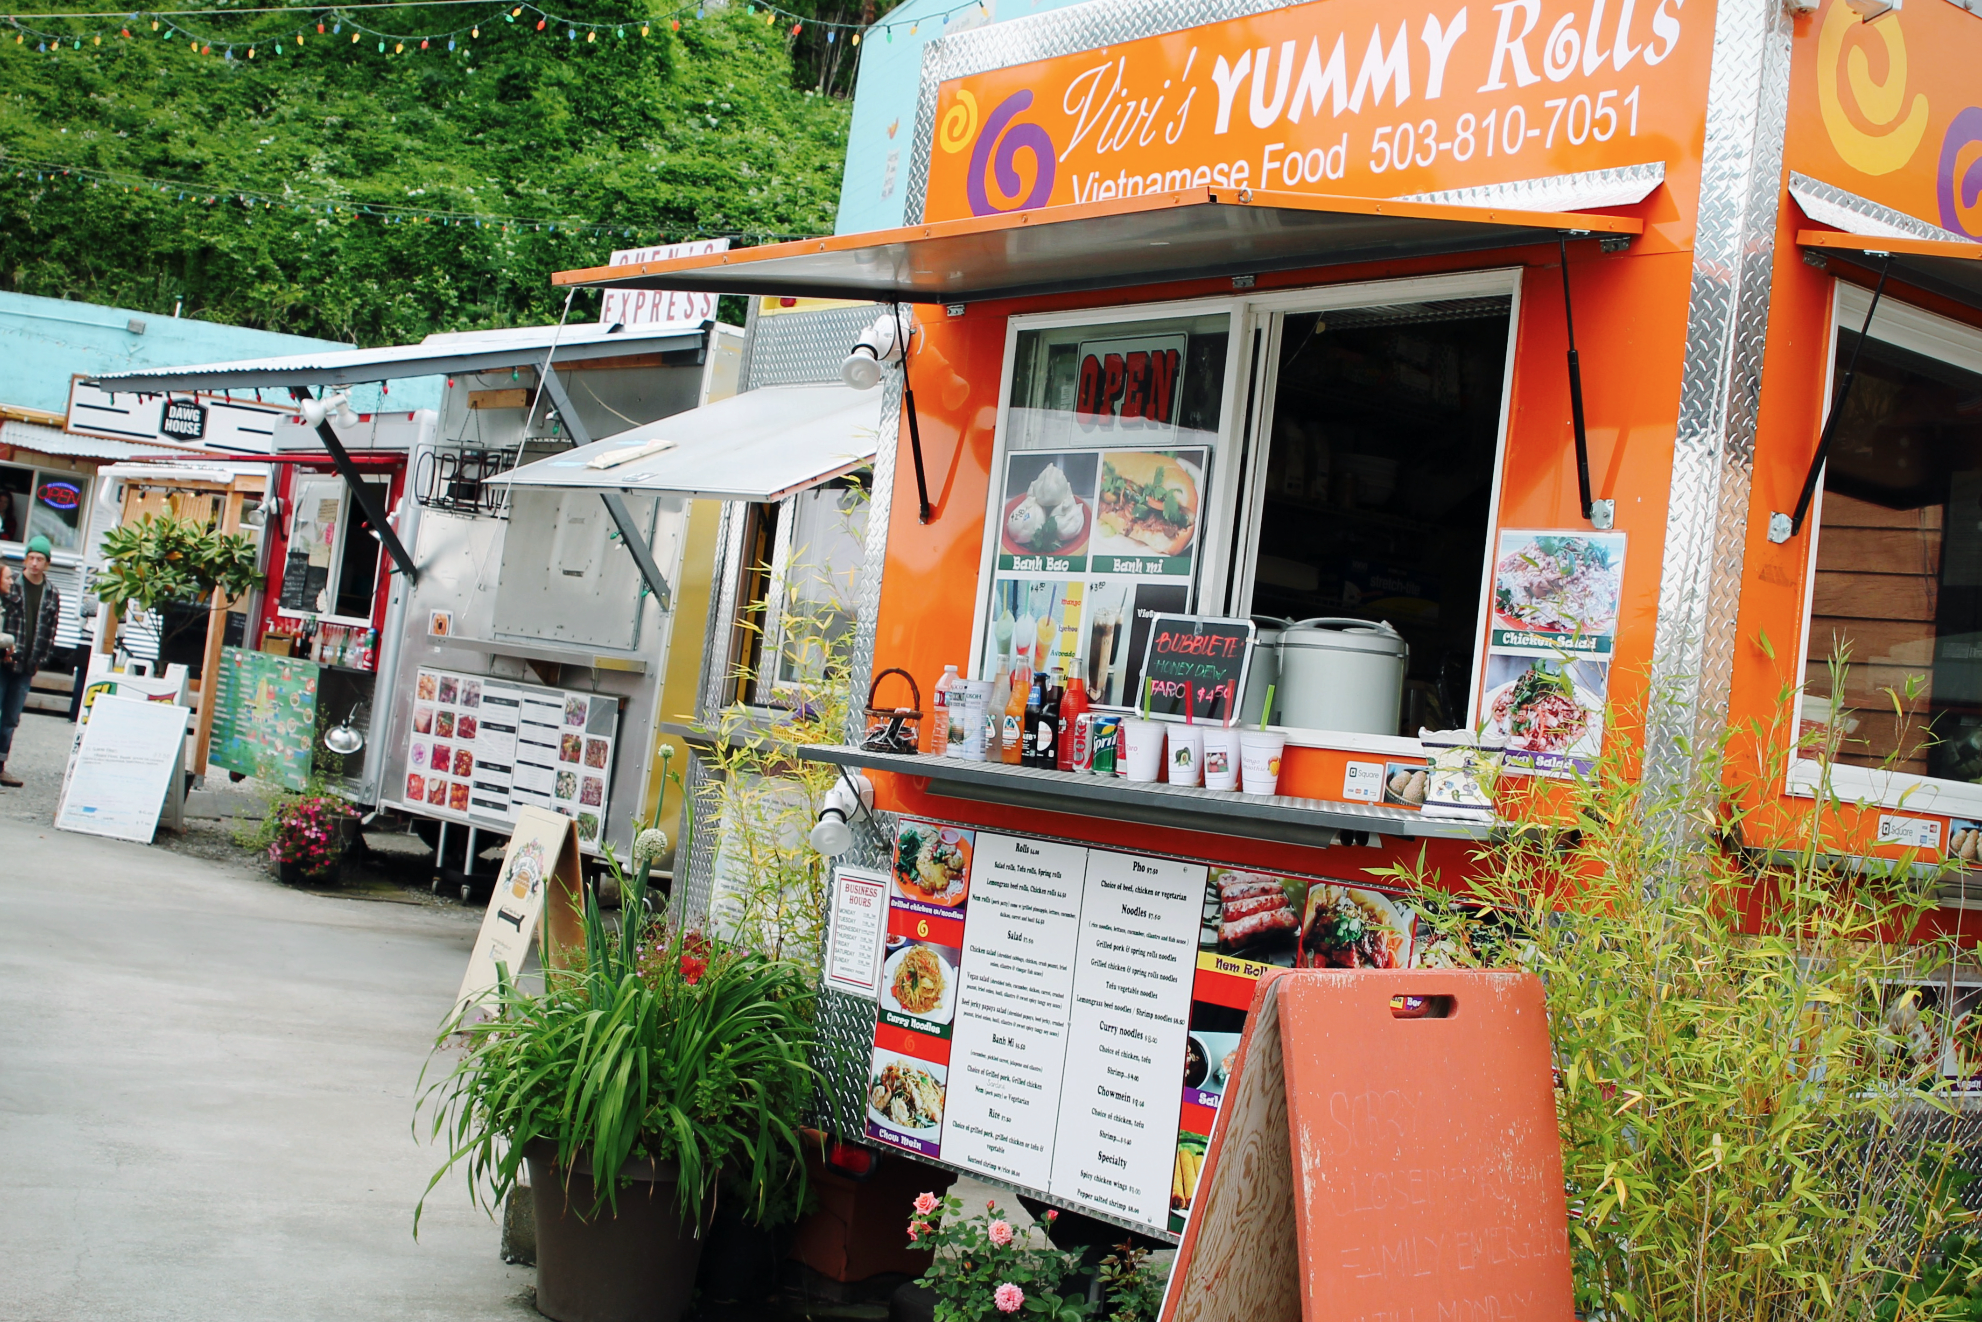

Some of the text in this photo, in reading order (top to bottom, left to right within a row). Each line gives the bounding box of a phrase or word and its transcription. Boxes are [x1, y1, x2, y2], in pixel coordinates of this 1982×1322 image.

[1059, 0, 1685, 163] Vivi's YUMMY Rolls
[1261, 132, 1348, 190] Food
[1369, 85, 1640, 174] 503-810-7051
[603, 290, 711, 324] EXPRESS
[1076, 348, 1180, 432] OPEN
[168, 406, 201, 422] DAWG
[164, 418, 201, 436] HOUSE
[37, 484, 82, 507] OPEN
[1012, 556, 1070, 573] Banh Bao
[1113, 558, 1163, 574] Banh mi
[1557, 635, 1597, 650] Salad
[1154, 660, 1227, 680] HONEY DEW
[1150, 680, 1186, 698] TARO
[1536, 755, 1574, 769] Salad
[1358, 769, 1380, 779] Square
[1891, 825, 1913, 837] Square
[1016, 843, 1029, 854] Rolls
[1133, 861, 1146, 872] Pho
[845, 883, 878, 898] BUSINESS
[1101, 880, 1116, 889] Choice
[1123, 884, 1134, 892] beef,
[1135, 886, 1154, 896] chicken
[1162, 892, 1187, 901] vegetarian
[849, 895, 872, 908] HOURS
[839, 908, 856, 916] MONDAY
[1122, 904, 1147, 918] Noodles
[838, 915, 856, 924] TUESDAY
[837, 932, 857, 941] THURSDAY
[838, 924, 861, 933] WEDNESDAY
[1008, 930, 1022, 941] Salad
[836, 939, 850, 947] FRIDAY
[1096, 940, 1112, 949] Grilled
[1131, 948, 1146, 958] spring
[1159, 954, 1176, 962] noodles
[835, 948, 855, 957] SATURDAY
[1091, 958, 1107, 968] Grilled
[1108, 962, 1126, 972] chicken
[1132, 969, 1147, 978] spring
[1148, 971, 1159, 979] rolls
[1160, 974, 1178, 983] noodles
[1215, 957, 1268, 977] Nem Roll
[1106, 981, 1158, 999] Tofu vegetable noodles
[1077, 994, 1103, 1007] Lemongrass
[1104, 1001, 1113, 1009] beef
[1114, 1005, 1132, 1013] noodles
[1136, 1008, 1153, 1020] Shrimp
[1154, 1014, 1172, 1023] noodles
[886, 1012, 941, 1035] Curry Noodles
[1100, 1020, 1118, 1036] Curry
[1119, 1028, 1143, 1040] noodles
[992, 1034, 1006, 1045] Banh
[1099, 1044, 1114, 1055] Choice
[1121, 1051, 1140, 1062] chicken,
[1141, 1056, 1151, 1064] tofu
[1026, 1080, 1042, 1090] chicken
[1008, 1094, 1029, 1106] Vegetarian
[1098, 1085, 1131, 1103] Chowmein
[1198, 1092, 1220, 1107] Sal
[989, 1108, 1000, 1119] Rice
[1092, 1108, 1107, 1118] Choice
[1114, 1114, 1133, 1126] chicken,
[1134, 1120, 1144, 1129] tofu
[879, 1128, 899, 1144] Chow
[1009, 1137, 1024, 1147] chicken
[1098, 1151, 1127, 1170] Specialty
[1080, 1170, 1127, 1191] Spicy chicken wings
[1077, 1188, 1126, 1211] Pepper salted shrimp
